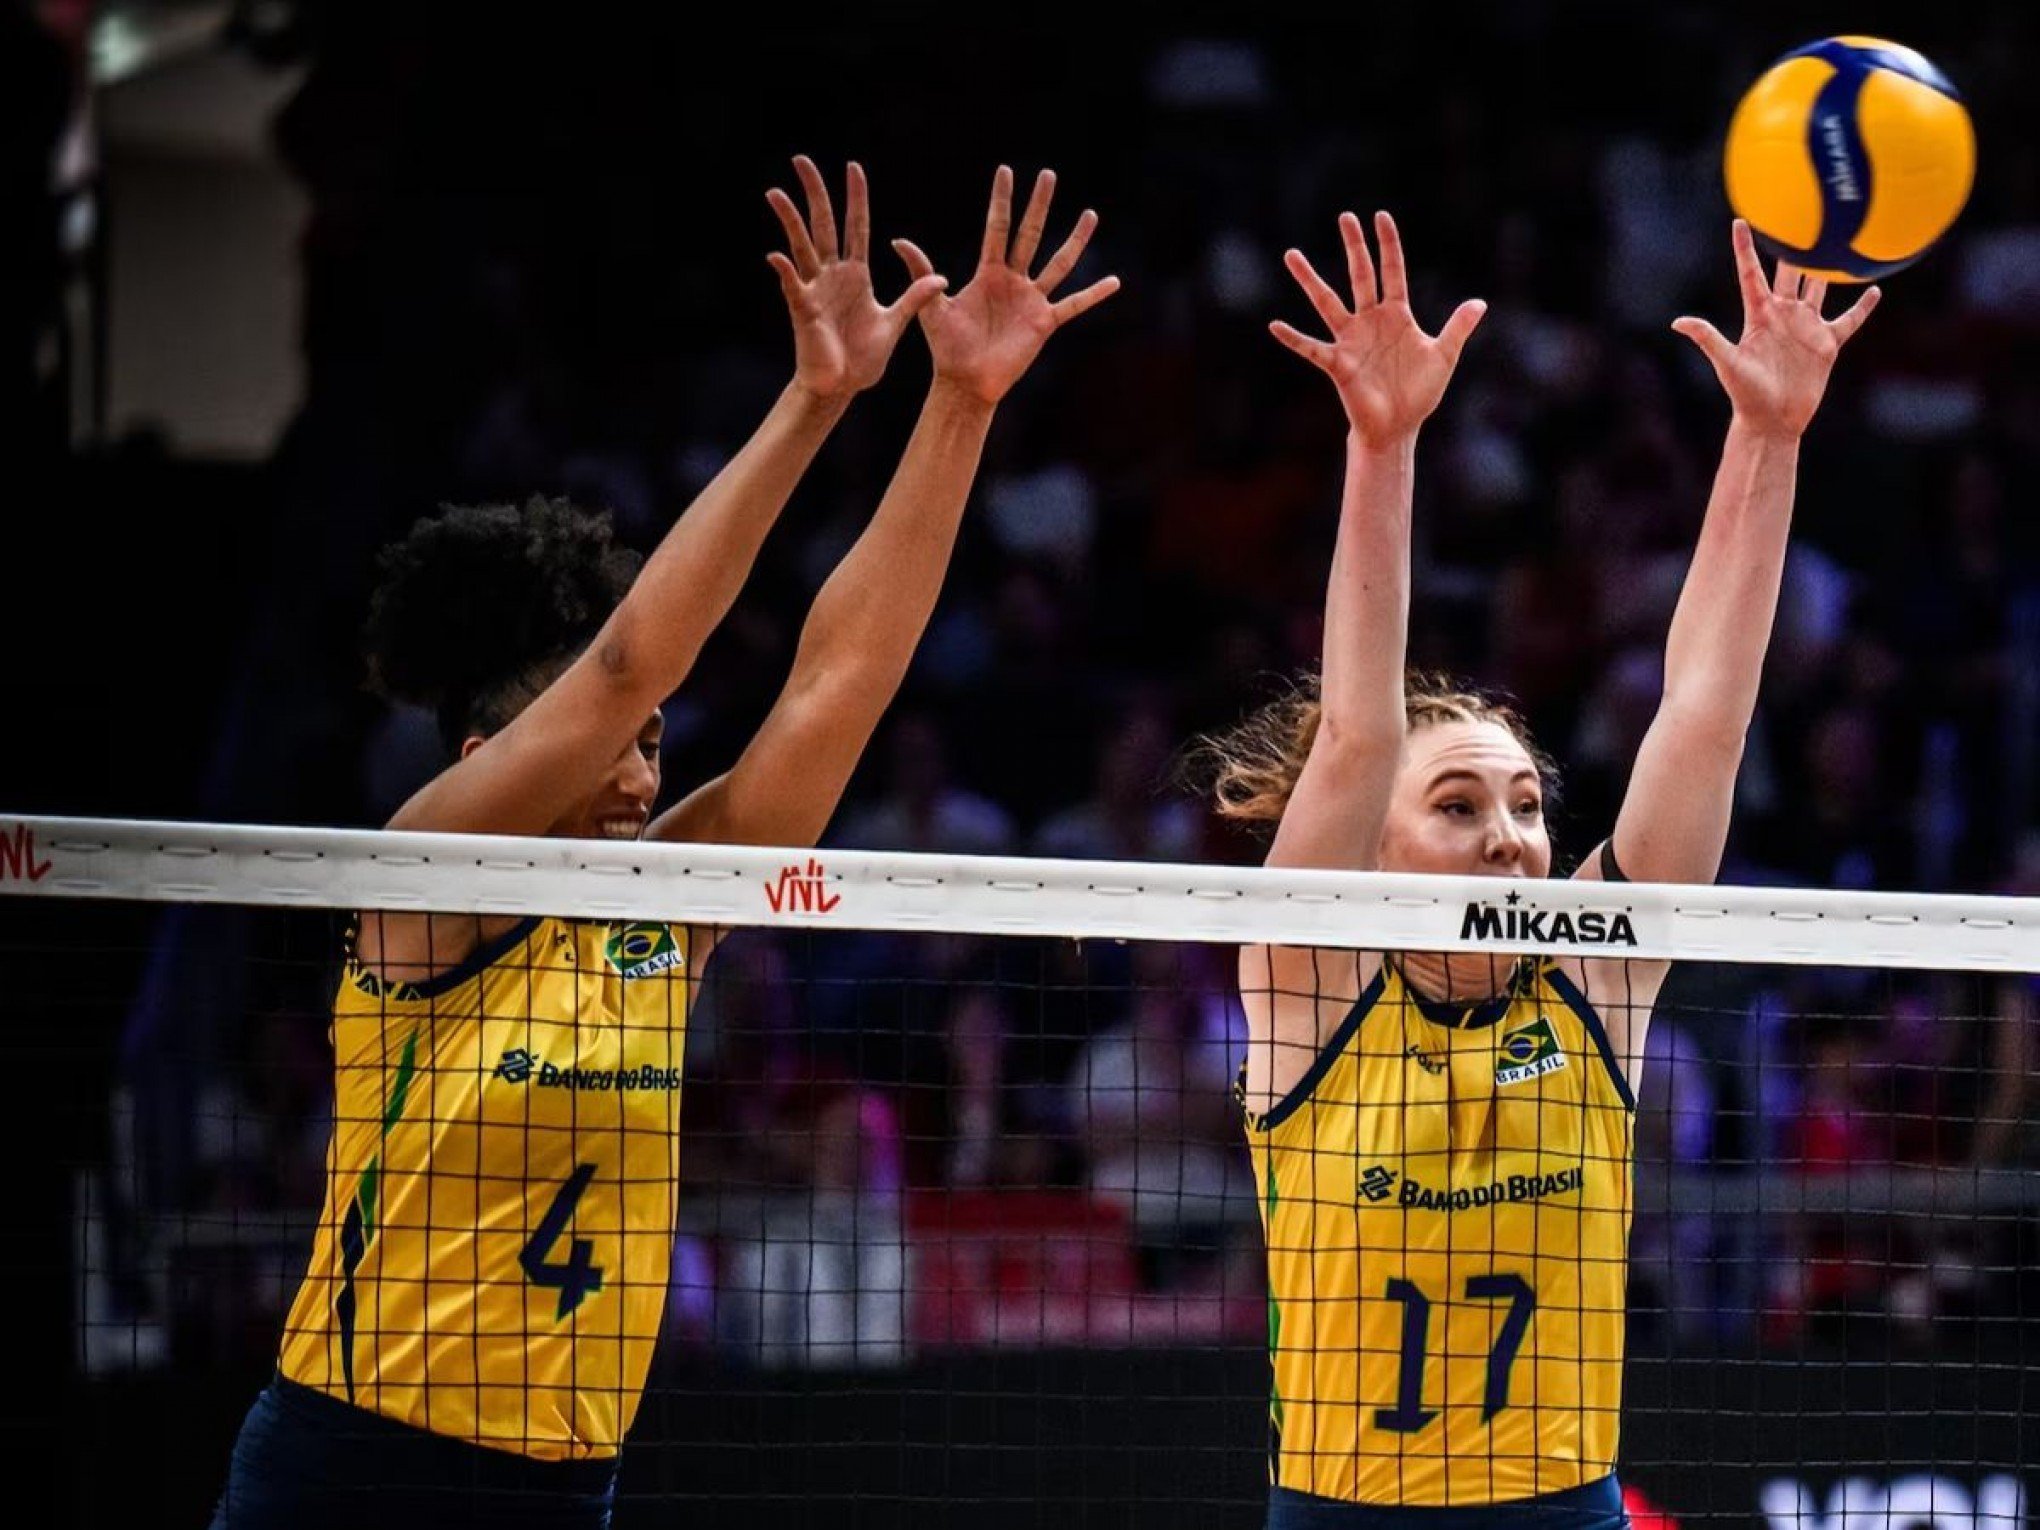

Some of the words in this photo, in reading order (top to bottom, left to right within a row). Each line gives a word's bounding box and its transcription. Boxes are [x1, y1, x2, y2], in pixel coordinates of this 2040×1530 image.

[765, 857, 841, 913] VNL
[1460, 902, 1637, 946] MIKASA
[1496, 1057, 1564, 1083] BRASIL
[1473, 1181, 1504, 1207] DO
[1508, 1167, 1584, 1201] BRASIL
[518, 1163, 604, 1322] 4
[1373, 1273, 1536, 1433] 17
